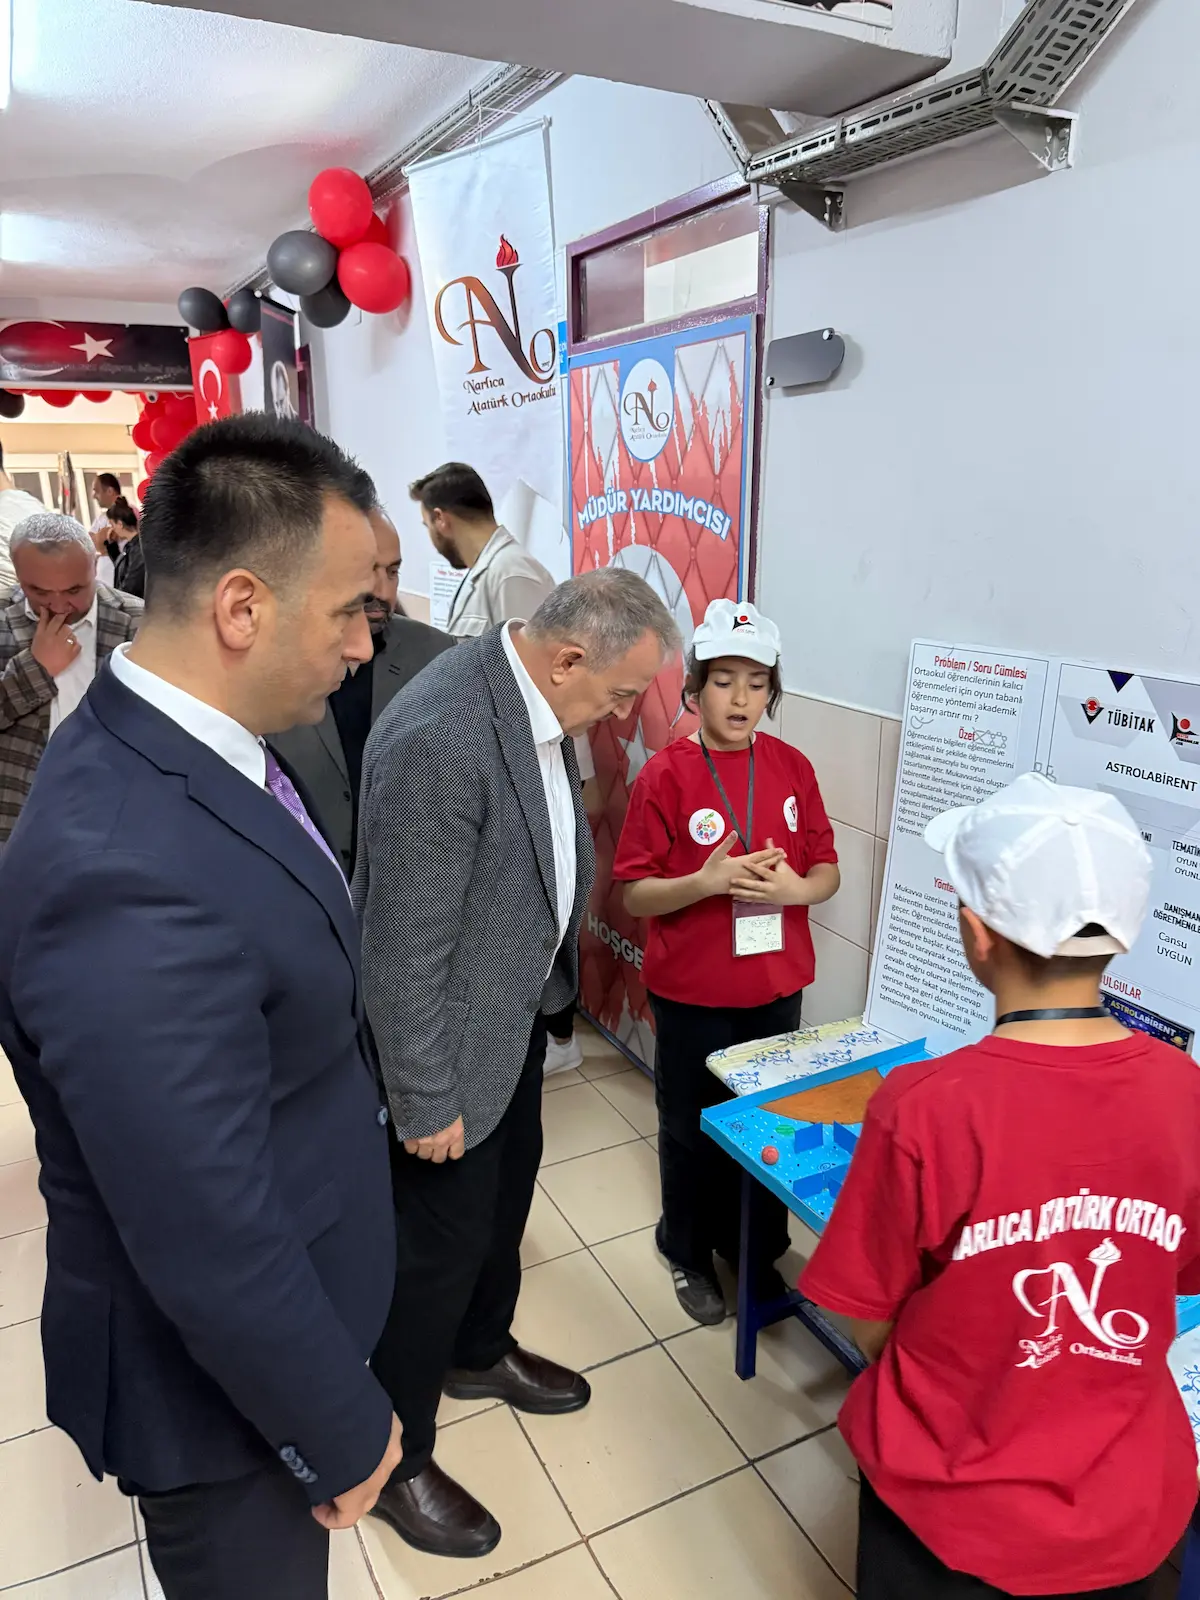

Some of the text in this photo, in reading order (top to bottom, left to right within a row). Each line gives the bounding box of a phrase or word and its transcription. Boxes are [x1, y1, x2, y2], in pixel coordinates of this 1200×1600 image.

[467, 395, 509, 415] Atatürk
[577, 487, 732, 540] MÜDÜR YARDIMCISI
[915, 667, 1023, 690] Ortaokul öğrencilerinin kalıcı
[934, 656, 966, 670] Problem
[973, 661, 992, 674] Soru
[994, 664, 1027, 679] Cümlesi
[913, 679, 957, 693] öğrenmeleri
[959, 688, 972, 697] için
[974, 691, 993, 700] oyun
[911, 691, 1016, 716] öğrenme yöntemi akademik
[962, 713, 972, 721] mı
[1108, 709, 1155, 733] TÜBİTAK
[907, 729, 942, 743] Öğrencilerin
[944, 737, 966, 748] bilgileri
[959, 726, 975, 741] Özet
[905, 750, 931, 760] sağlamak
[970, 765, 985, 773] oyun
[946, 750, 967, 759] şekilde
[969, 754, 1014, 769] öğrenmelerini
[902, 778, 915, 786] kodu
[961, 783, 972, 791] için
[1105, 761, 1198, 792] ASTROLABİRENT
[900, 797, 920, 807] öğrenci
[897, 825, 921, 837] öğrenme
[1176, 856, 1197, 868] OYUN
[895, 883, 922, 897] Mukavva
[924, 893, 948, 906] üzerine
[893, 893, 955, 920] labirentin başına iki
[889, 923, 922, 941] ilerlemeye
[890, 913, 920, 929] labirentte
[922, 925, 936, 935] yolu
[912, 909, 957, 932] Öğrencilerden
[888, 933, 897, 941] QR
[899, 937, 914, 949] kodu
[916, 944, 946, 960] tarayarak
[1158, 931, 1187, 949] Cansu
[886, 943, 908, 956] sürede
[909, 953, 951, 973] cevaplamaya
[1157, 945, 1192, 966] UYGUN
[884, 964, 981, 1008] devam eder fakat yanlış cevap
[885, 954, 985, 998] cevabı doğru olursa ilerlemeye
[1101, 975, 1141, 1000] ULGULAR
[880, 992, 918, 1015] tamamlayan
[919, 1009, 940, 1024] oyunu
[881, 983, 972, 1026] oyuncuya geçer. Labirenti ilk
[904, 980, 919, 993] başa
[920, 989, 934, 999] geri
[935, 995, 955, 1008] döner
[956, 1003, 969, 1014] sıra
[970, 1010, 988, 1021] ikinci
[1111, 1000, 1176, 1036] ASTROLABİRENT
[952, 1209, 1033, 1261] ARLICA
[1116, 1197, 1186, 1252] ORTAO
